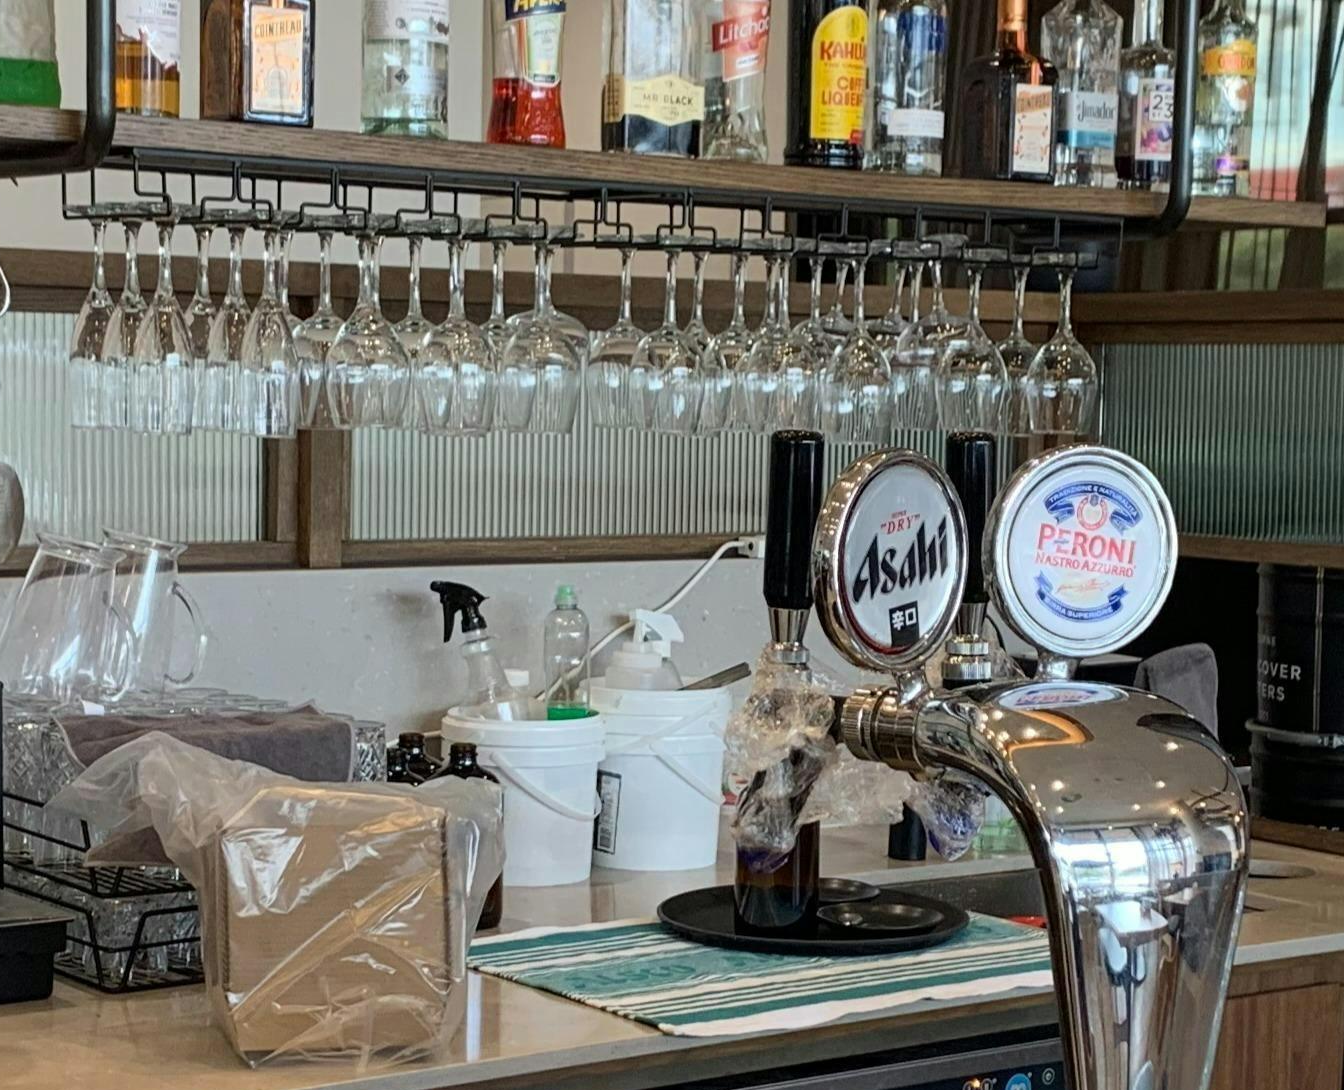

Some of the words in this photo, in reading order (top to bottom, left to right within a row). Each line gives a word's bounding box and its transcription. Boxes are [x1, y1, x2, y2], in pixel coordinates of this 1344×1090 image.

[663, 94, 693, 106] BLACK
[852, 514, 948, 604] Asahi
[1037, 522, 1137, 565] PERONI
[1035, 552, 1080, 570] NASTRO
[1081, 561, 1134, 579] AZZURRO
